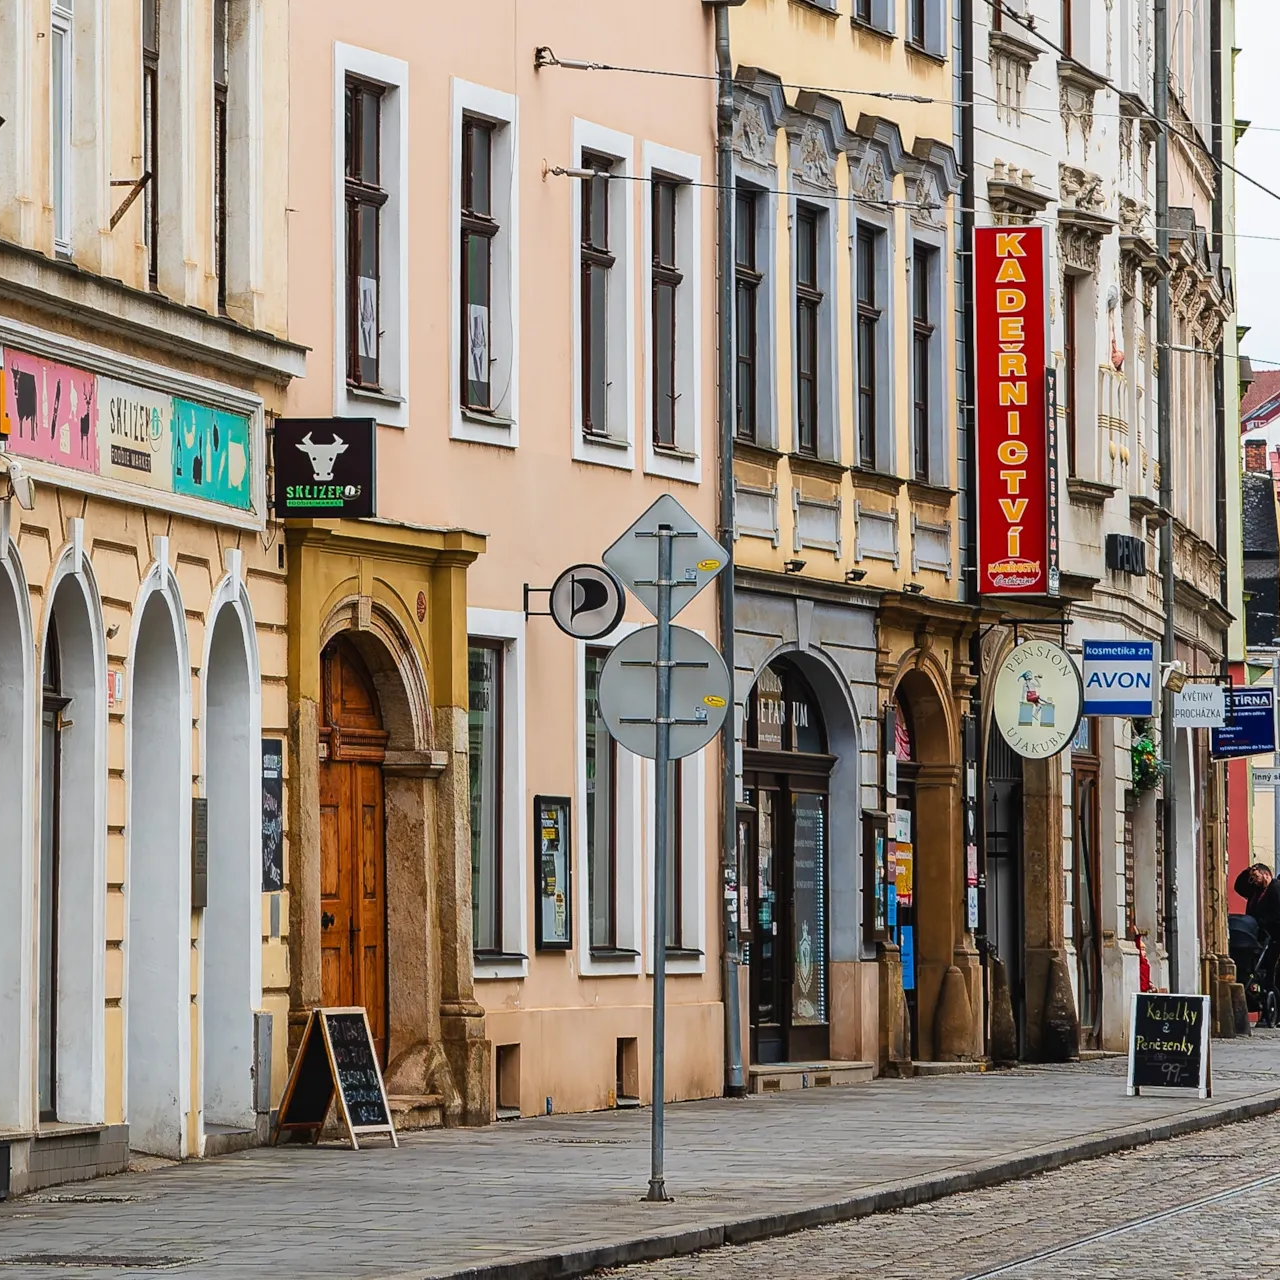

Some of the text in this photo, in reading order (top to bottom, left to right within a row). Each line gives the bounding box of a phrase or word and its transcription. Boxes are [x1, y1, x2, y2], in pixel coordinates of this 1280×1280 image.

[995, 232, 1029, 558] KADEŘNICTVÍ
[111, 448, 130, 465] FOODIE
[1086, 646, 1136, 655] kosmetika
[1005, 646, 1071, 677] PENSION
[1086, 672, 1151, 688] AVON
[1182, 691, 1213, 702] KVĚTINY
[1226, 695, 1269, 705] STÍRNA
[1175, 708, 1221, 718] PROCHÁZKA
[1006, 727, 1066, 754] U JAKUBA
[1147, 1001, 1197, 1025] Kabelky
[1162, 1022, 1170, 1033] a
